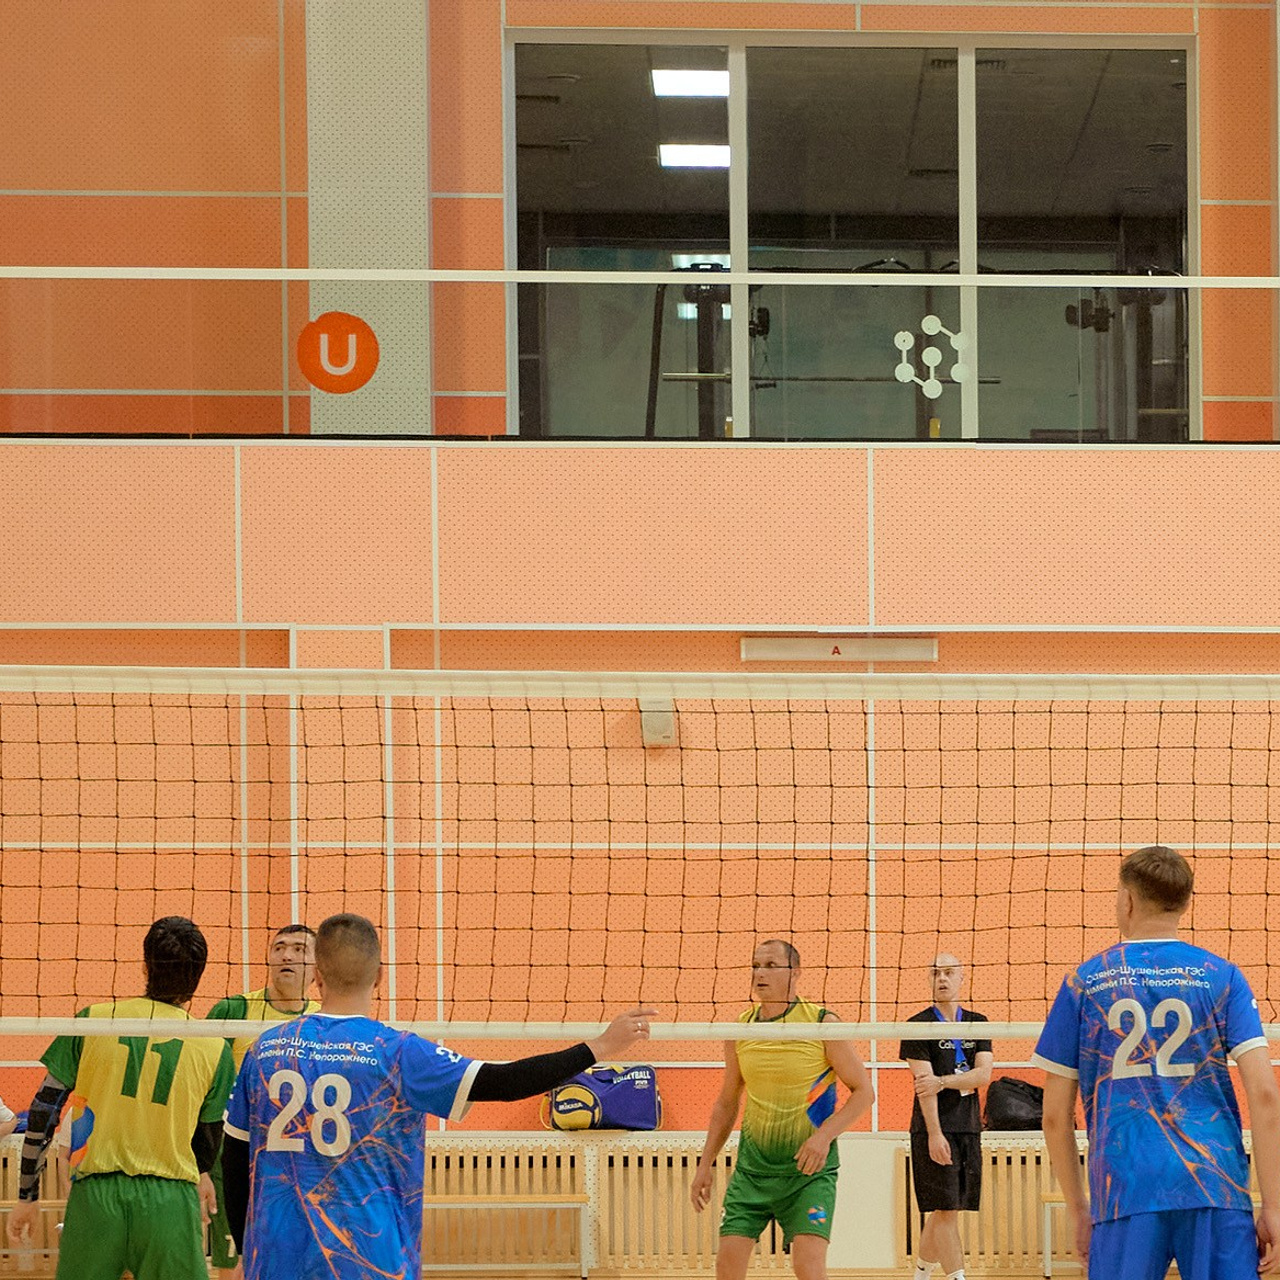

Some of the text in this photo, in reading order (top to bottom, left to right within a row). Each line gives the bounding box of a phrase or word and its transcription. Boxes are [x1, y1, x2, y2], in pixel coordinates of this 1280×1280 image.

[320, 333, 357, 376] U
[1185, 966, 1206, 977] ГЭС
[352, 1041, 375, 1053] ГЭС
[1107, 998, 1196, 1080] 22
[118, 1036, 184, 1106] 11
[266, 1069, 352, 1157] 28
